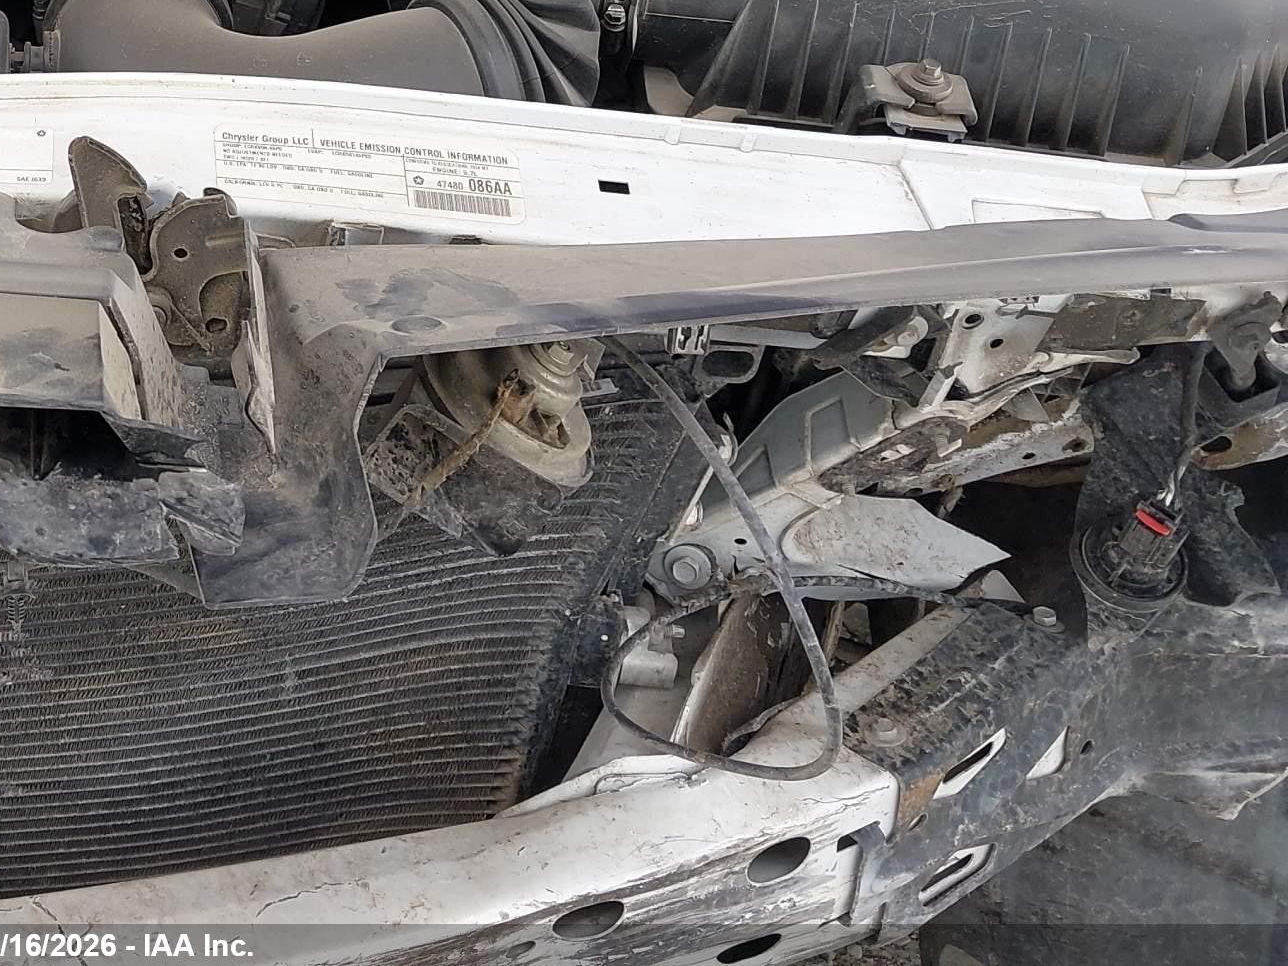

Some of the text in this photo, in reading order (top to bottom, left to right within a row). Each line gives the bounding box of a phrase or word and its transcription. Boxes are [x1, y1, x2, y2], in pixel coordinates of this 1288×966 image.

[222, 131, 309, 146] Chrysler Group LLC
[320, 139, 508, 165] VEHICLE EMISSION CONTROL INFORMATION
[436, 178, 513, 195] 47480 086AA
